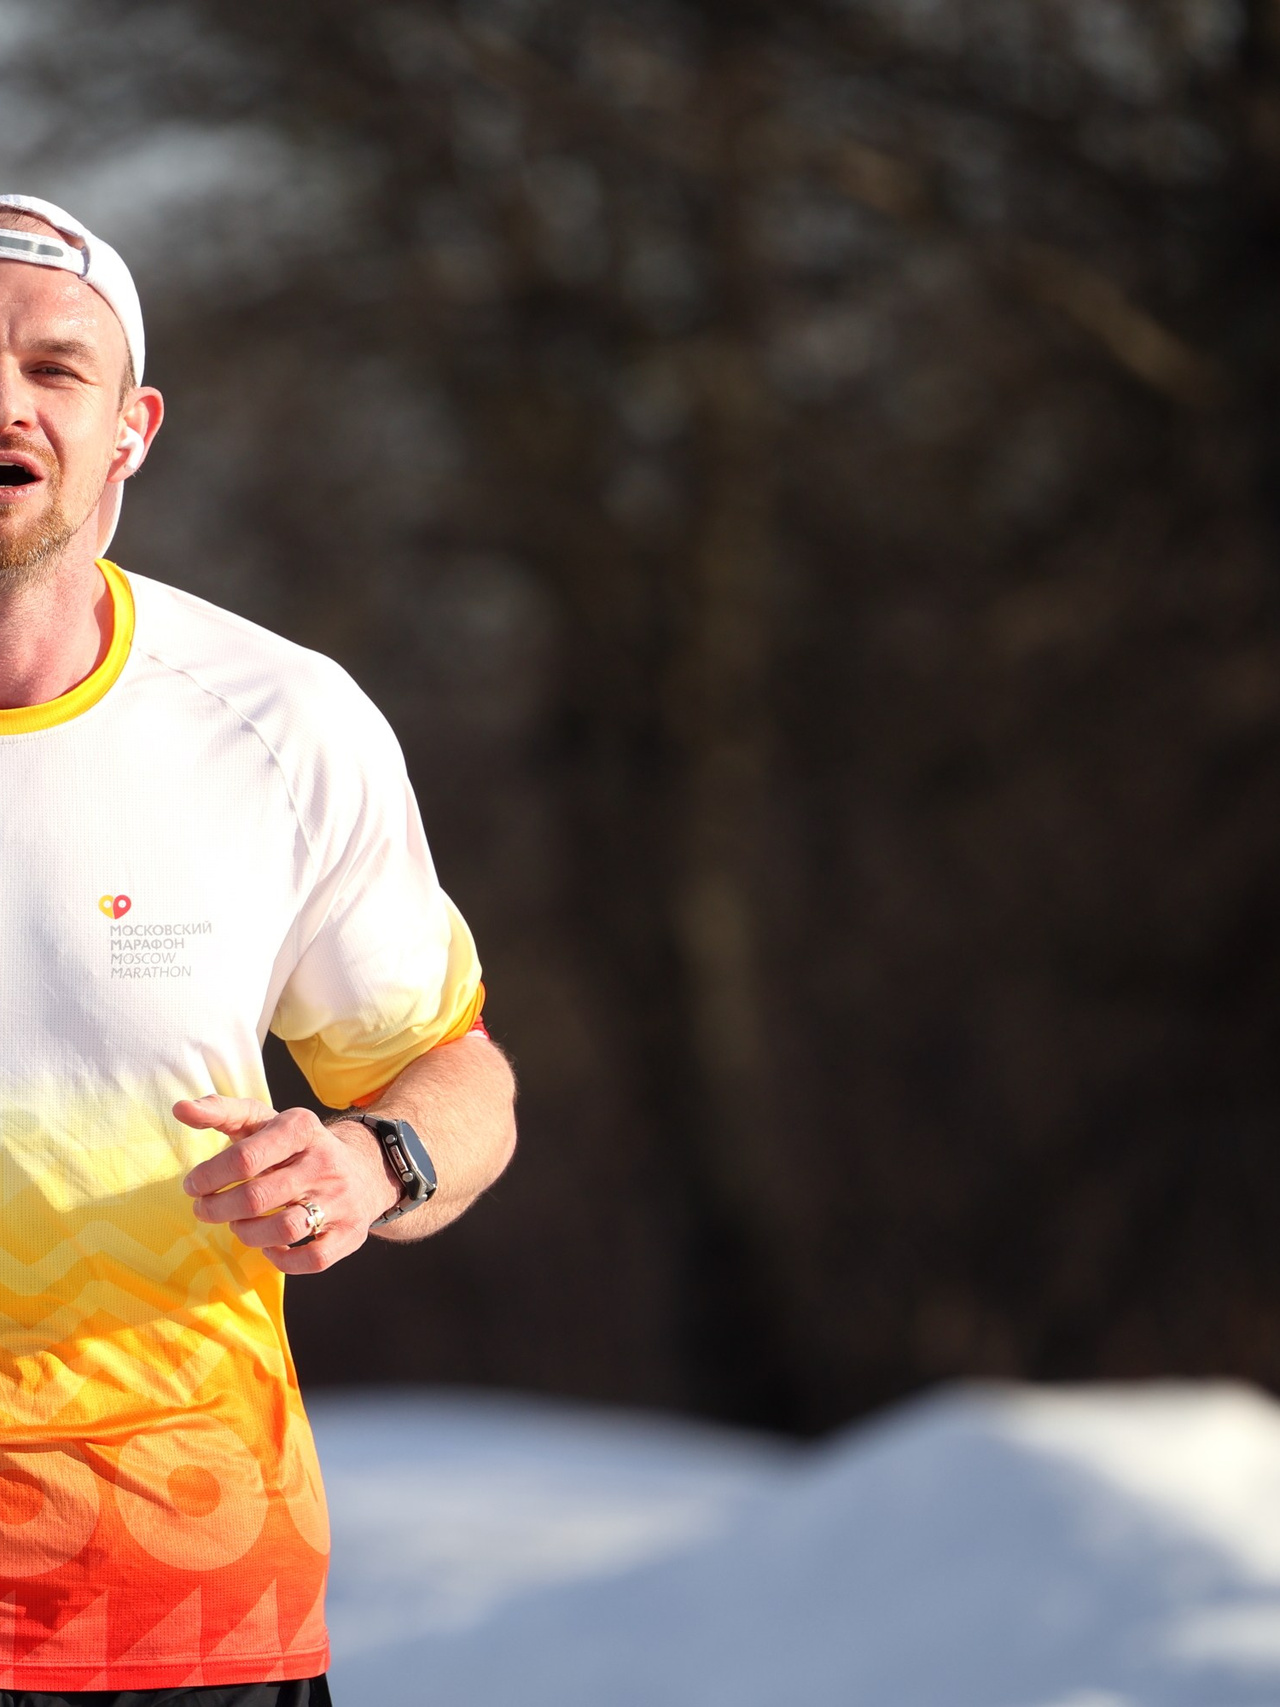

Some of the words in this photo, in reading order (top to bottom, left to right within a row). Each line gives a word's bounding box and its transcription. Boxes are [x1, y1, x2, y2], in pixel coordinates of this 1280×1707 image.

[110, 920, 213, 937] МОСКОВСКИЙ
[110, 937, 185, 951] МАРАФОН
[110, 952, 177, 965] MOSCOW
[110, 965, 192, 979] MARATHON
